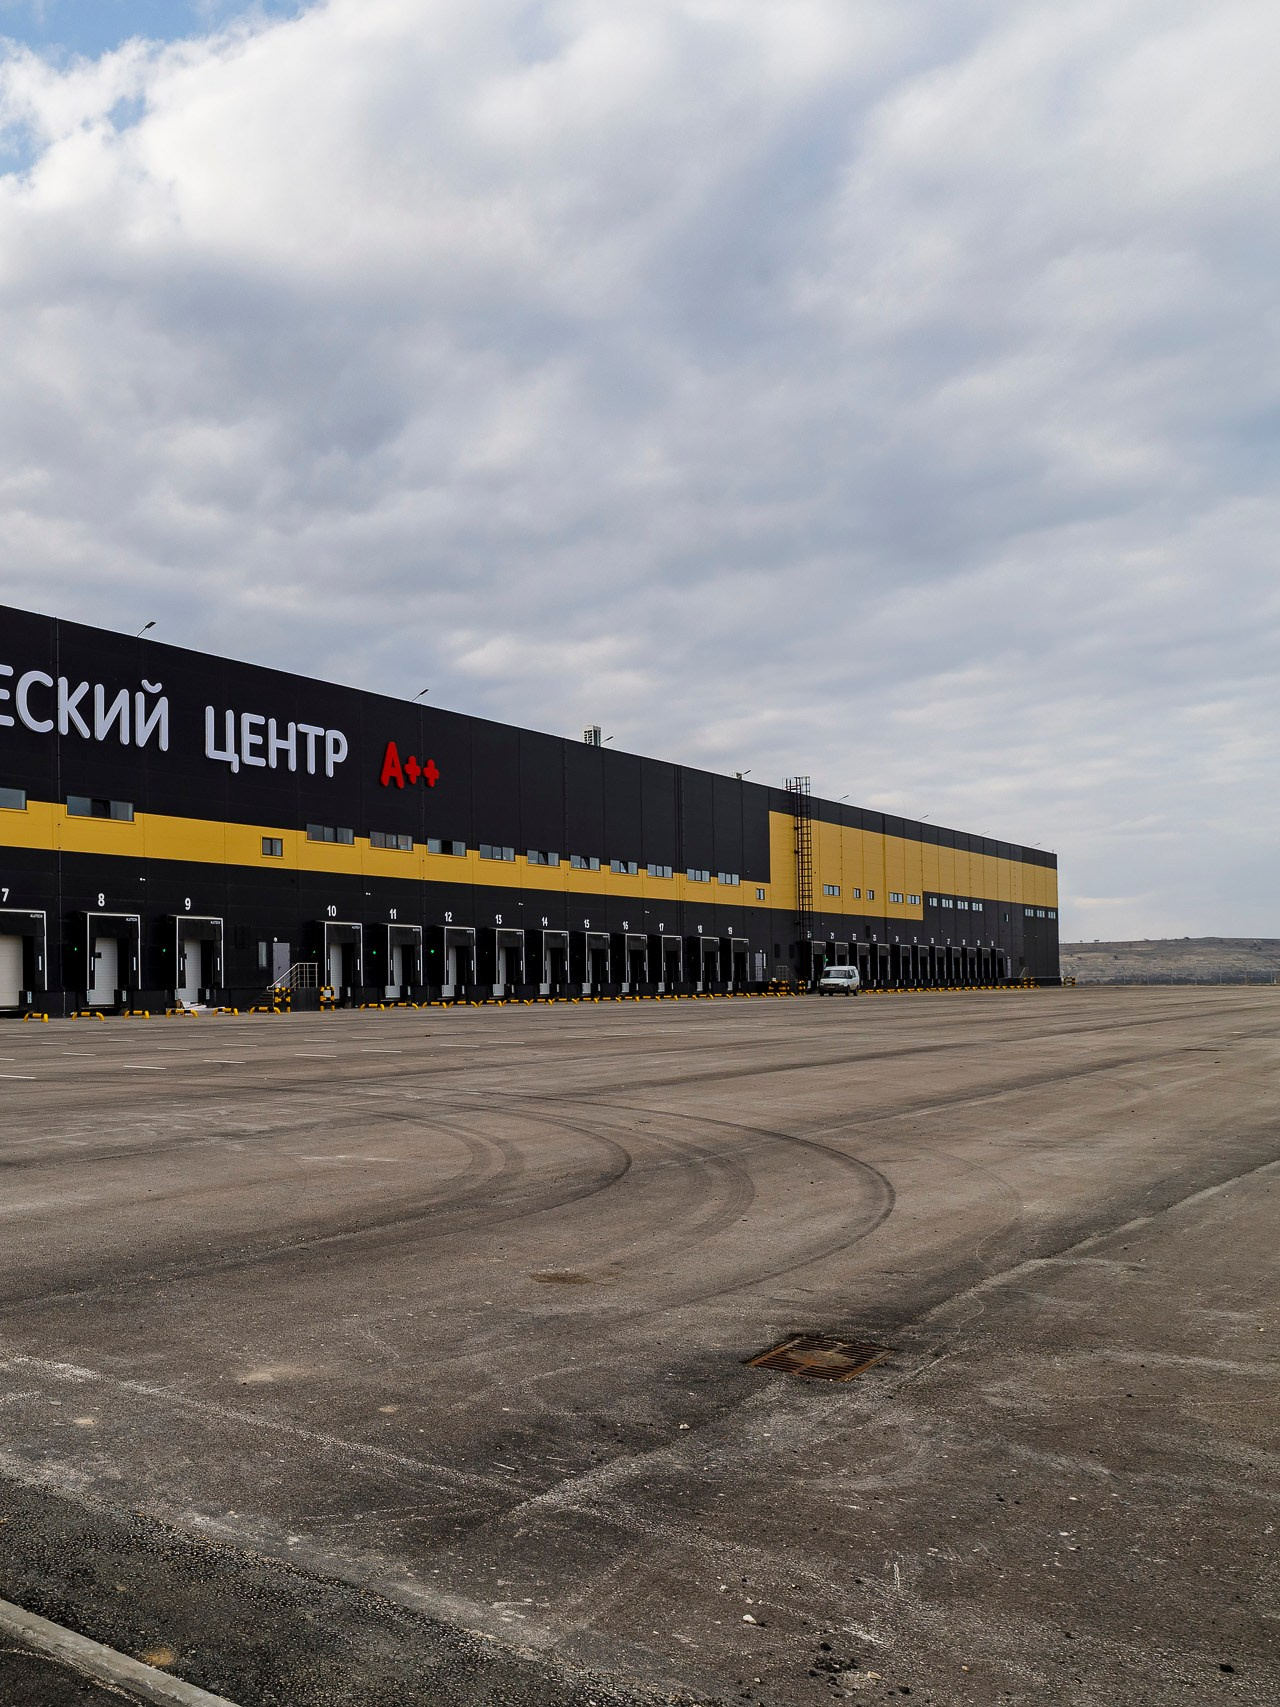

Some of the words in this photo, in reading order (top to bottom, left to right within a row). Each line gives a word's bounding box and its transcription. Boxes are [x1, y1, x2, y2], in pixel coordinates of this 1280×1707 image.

[205, 705, 349, 778] ЦЕНТР
[1, 888, 9, 902] 7
[98, 893, 105, 907] 8
[184, 898, 191, 911] 9
[327, 905, 337, 917] 10
[390, 909, 397, 920] 11
[445, 912, 452, 922] 12
[495, 915, 502, 924] 13
